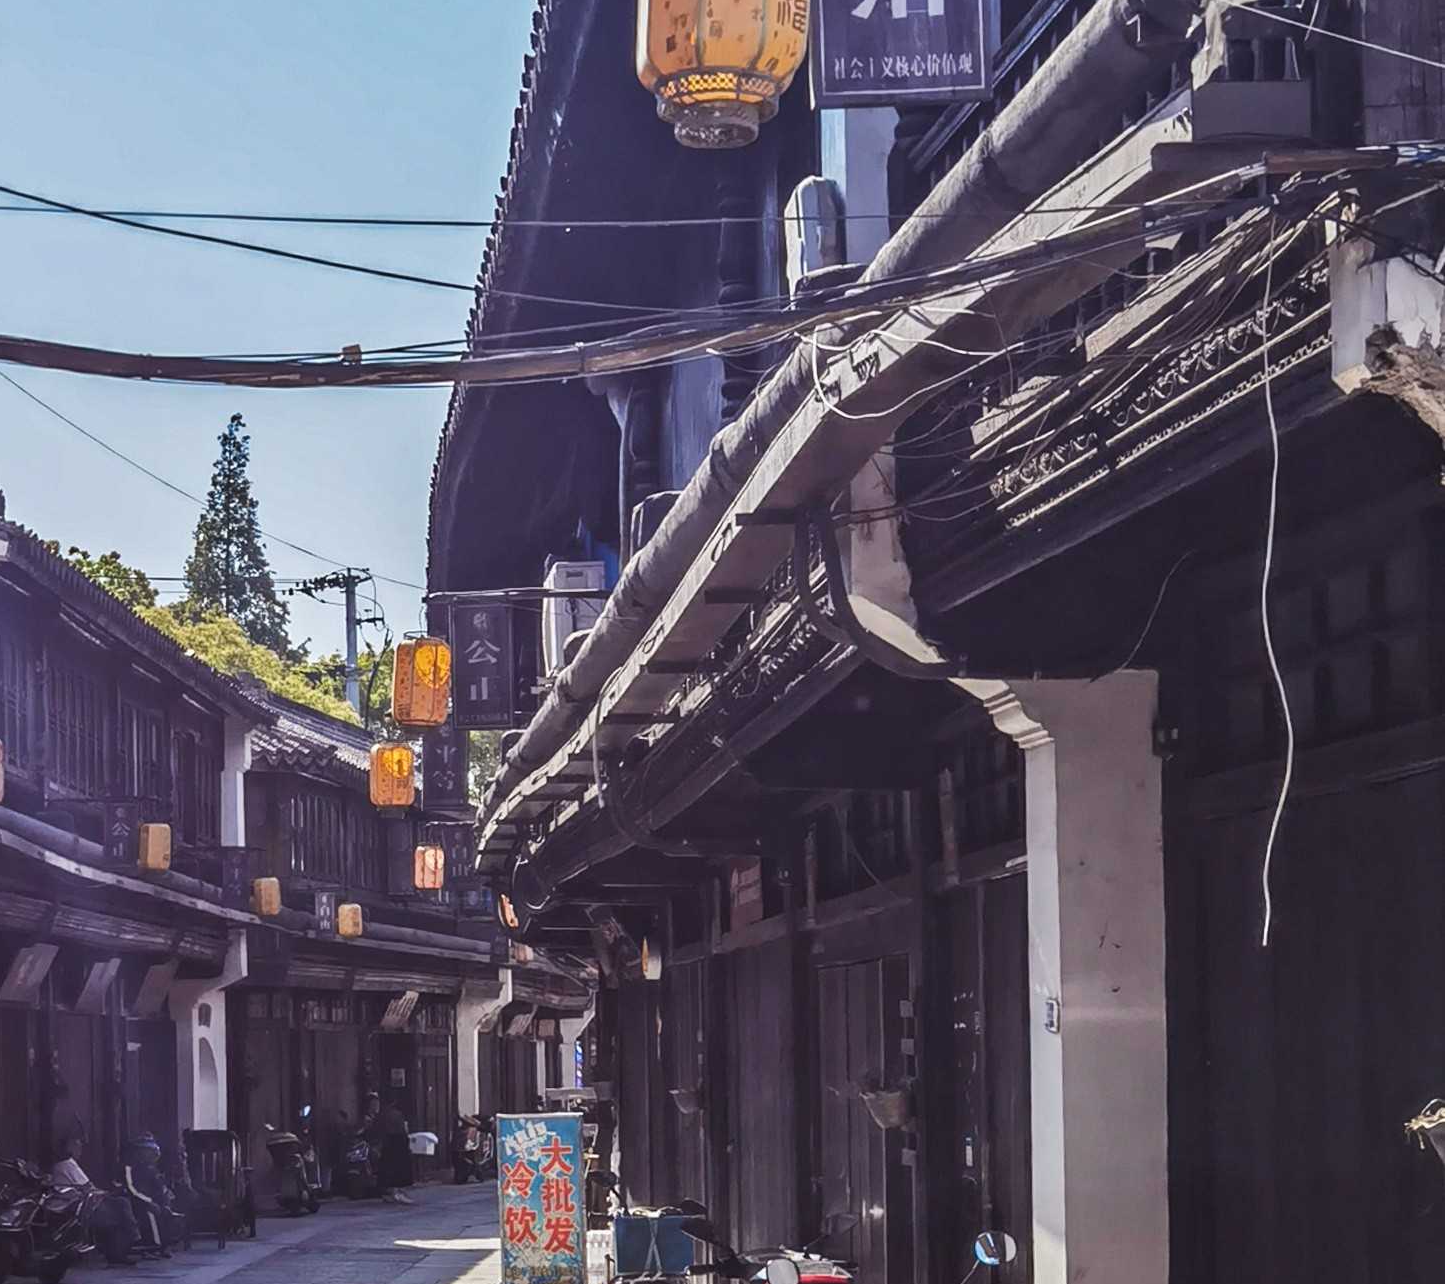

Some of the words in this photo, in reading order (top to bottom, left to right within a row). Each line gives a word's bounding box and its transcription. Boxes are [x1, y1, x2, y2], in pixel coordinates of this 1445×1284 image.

[502, 1158, 538, 1244] 冷饮
[539, 1135, 577, 1255] 大批发
